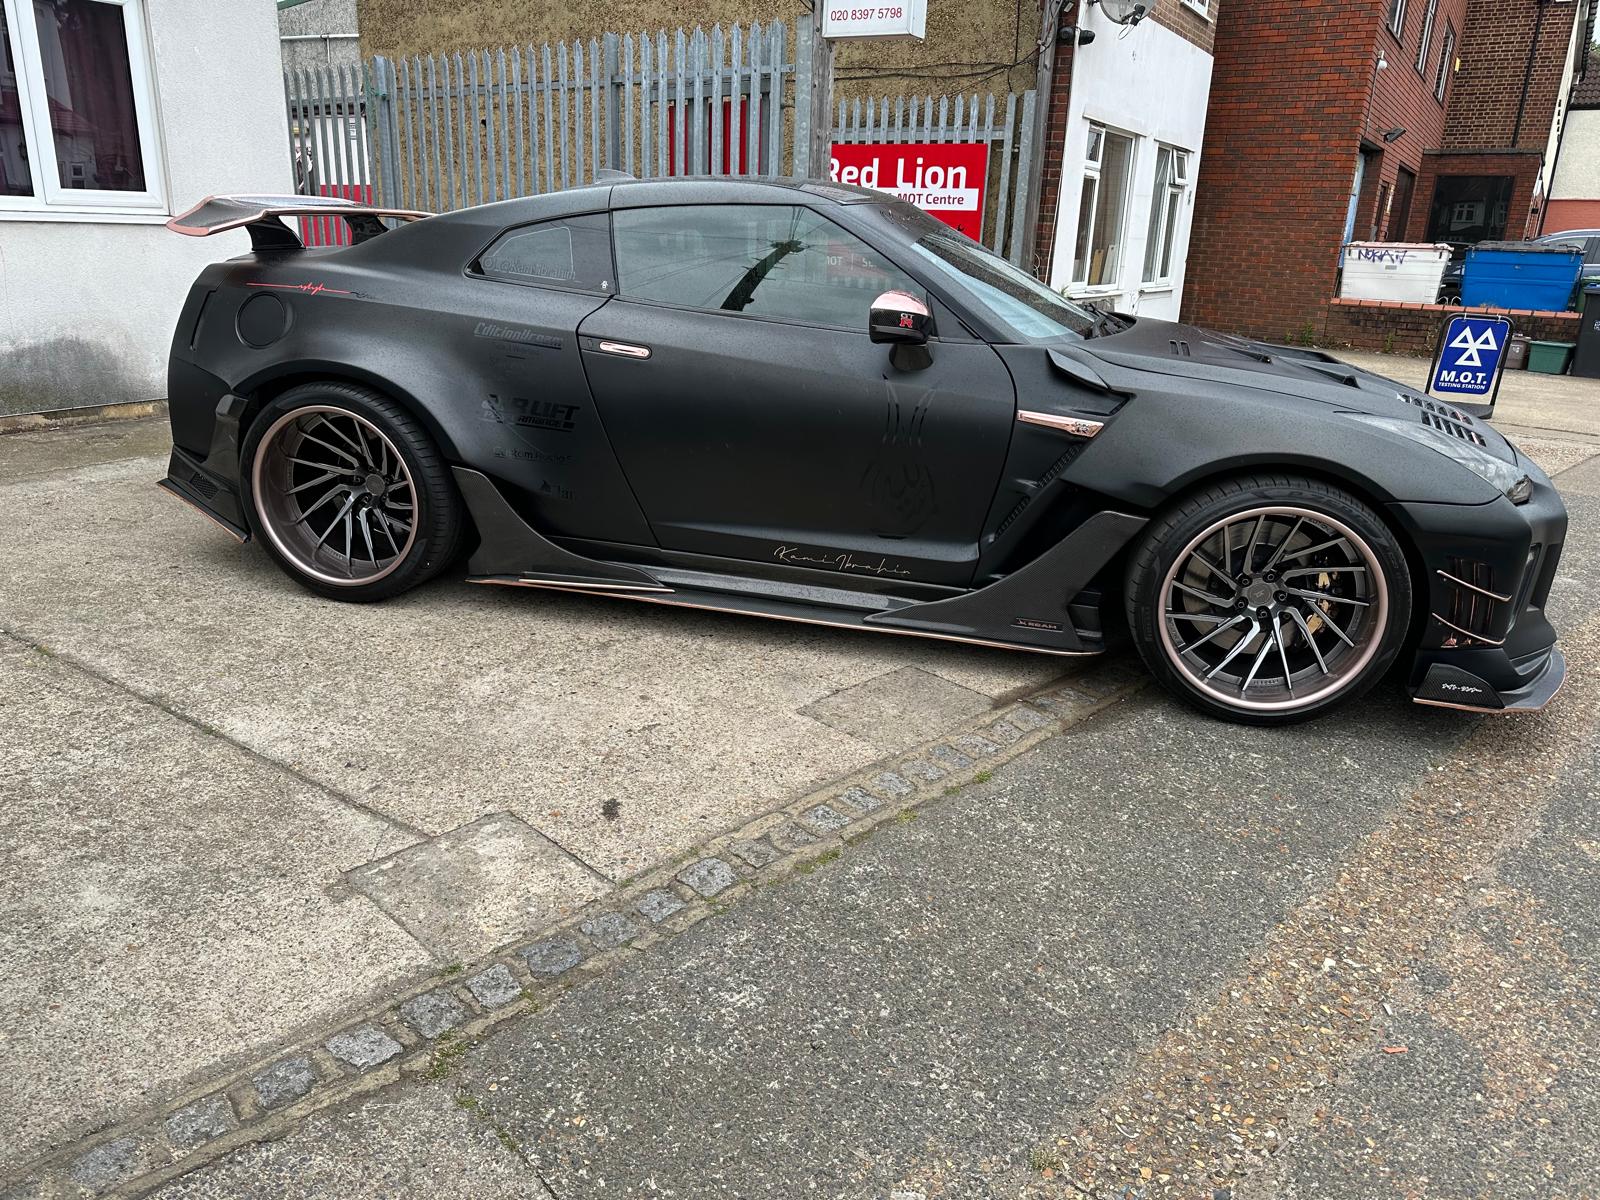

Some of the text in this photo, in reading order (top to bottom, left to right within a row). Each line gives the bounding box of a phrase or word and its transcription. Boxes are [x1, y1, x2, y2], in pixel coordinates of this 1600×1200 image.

[830, 7, 903, 21] 020 8397 5798
[829, 157, 967, 189] Red Lion
[926, 193, 965, 205] Centre
[1440, 369, 1487, 384] M.O.T.
[1438, 381, 1461, 389] TESTING
